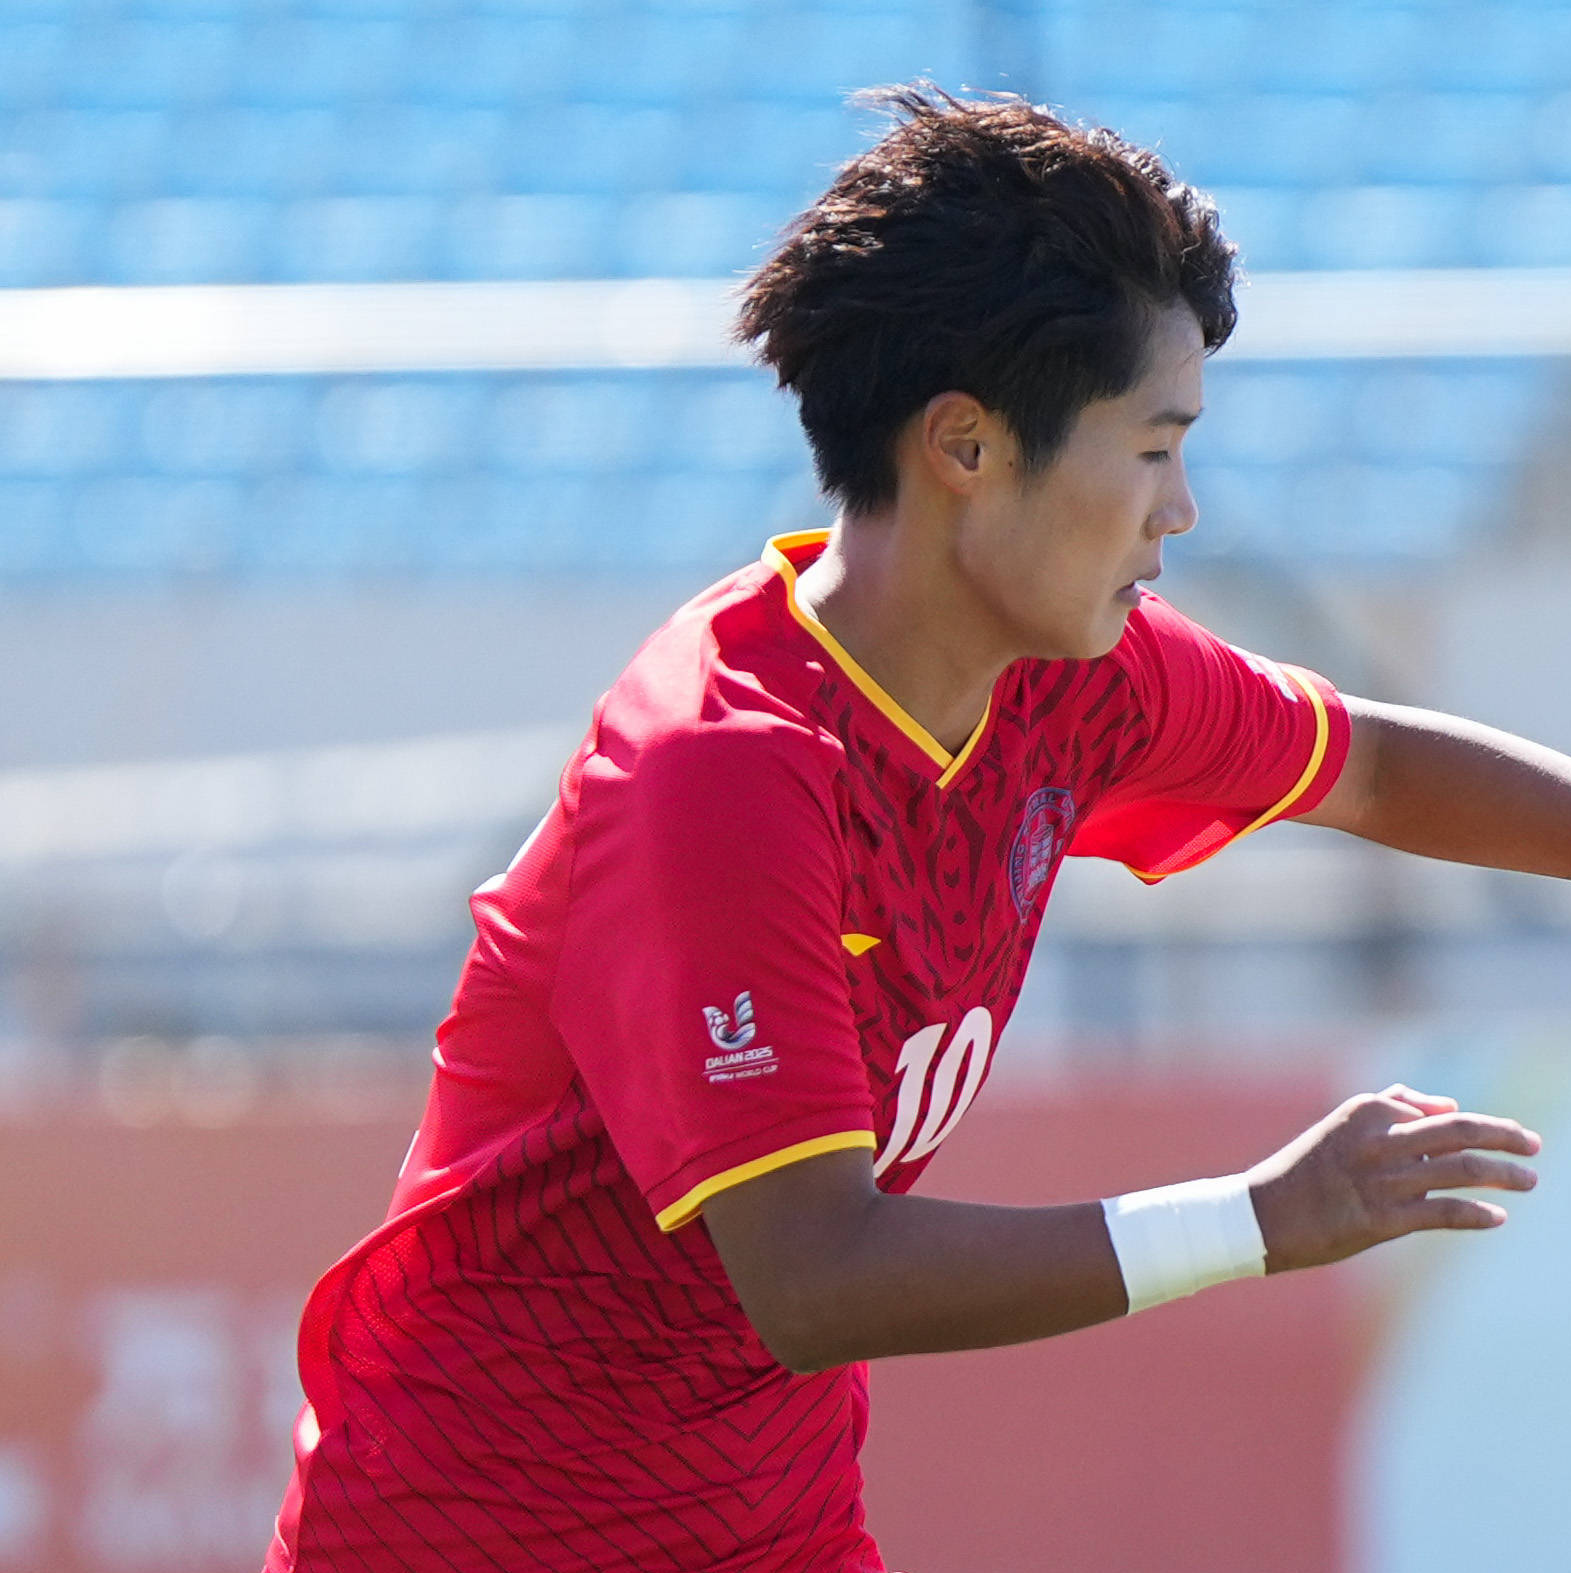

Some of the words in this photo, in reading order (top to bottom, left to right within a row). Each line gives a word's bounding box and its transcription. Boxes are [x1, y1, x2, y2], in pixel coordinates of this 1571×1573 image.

[705, 1052, 743, 1070] DALIAN
[744, 1046, 773, 1060] 2025
[874, 1006, 992, 1178] 10
